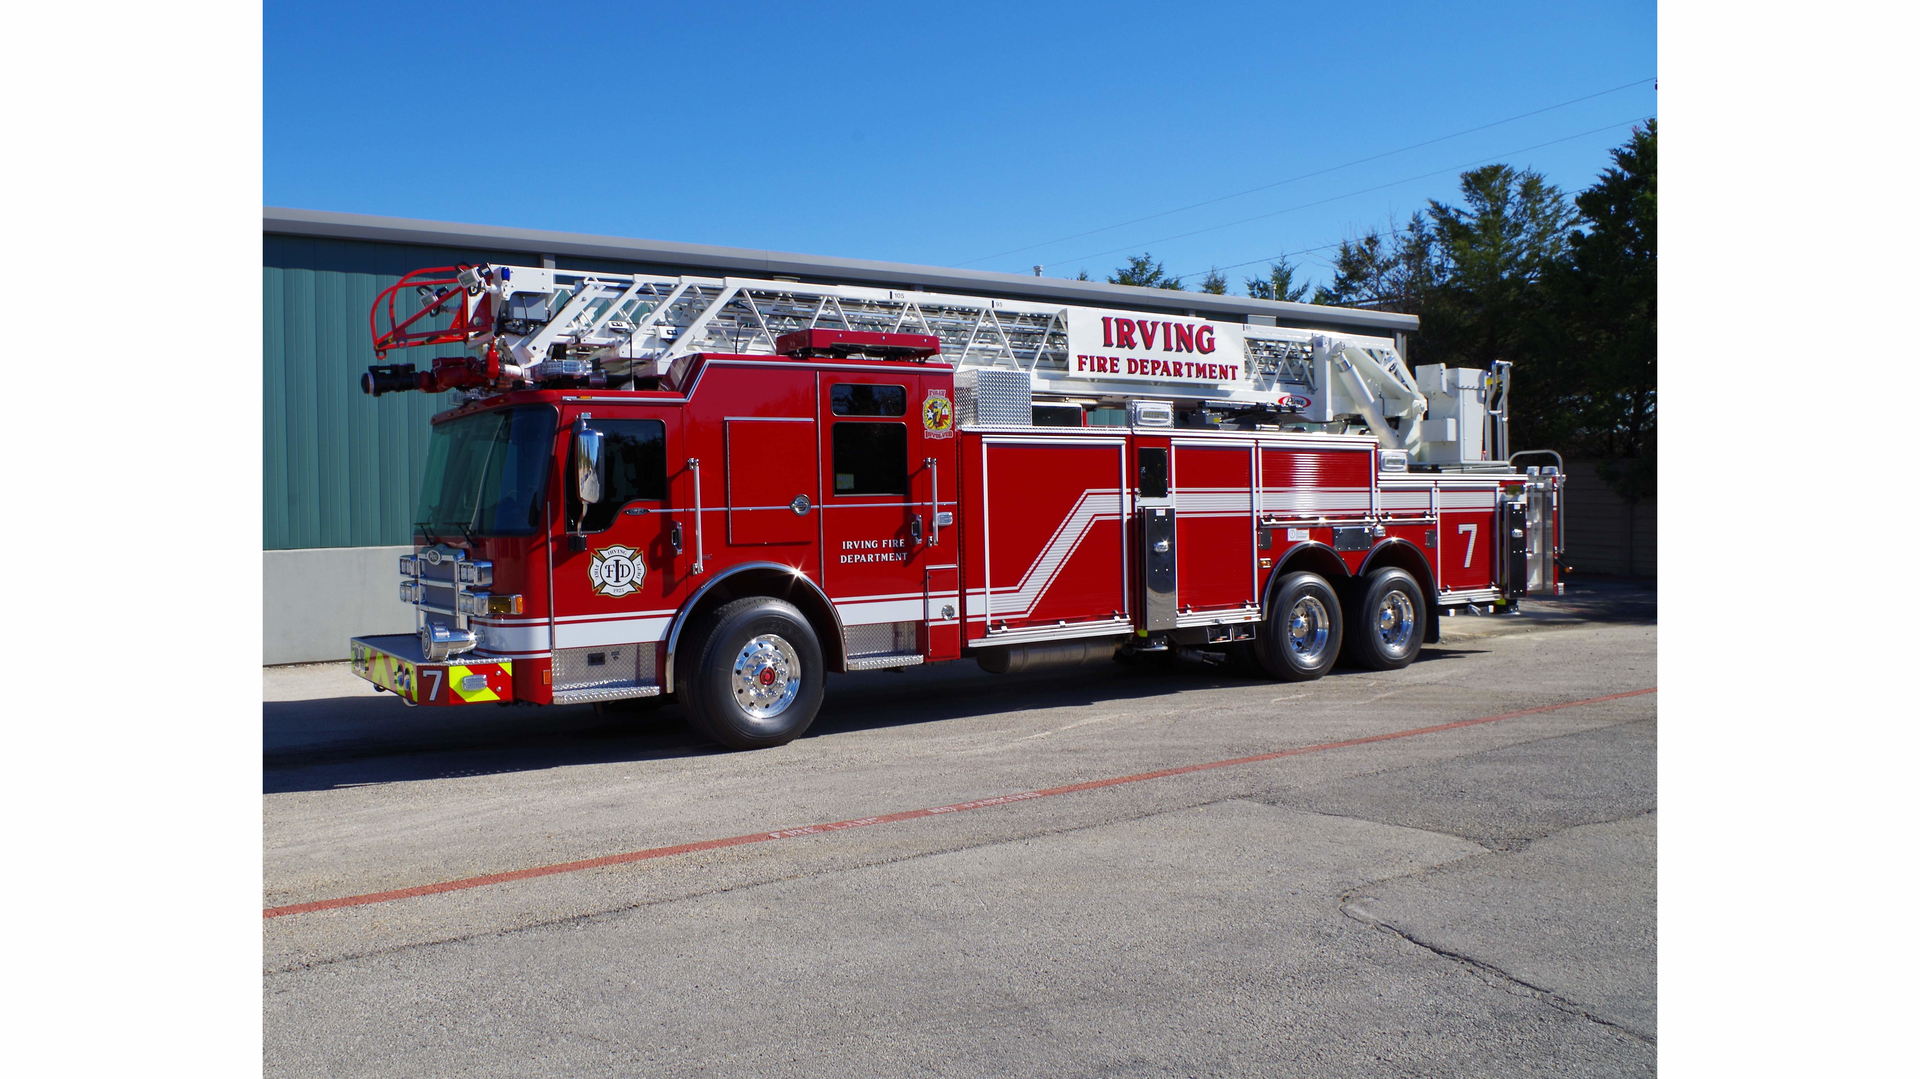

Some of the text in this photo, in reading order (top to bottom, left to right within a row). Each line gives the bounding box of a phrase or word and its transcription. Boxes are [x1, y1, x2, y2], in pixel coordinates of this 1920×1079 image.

[1101, 316, 1216, 355] IRVING
[1077, 354, 1238, 381] FIRE DEPARTMENT
[840, 552, 908, 564] DEPARTMENT
[842, 538, 905, 550] IRVING FIRE
[1458, 523, 1478, 568] 7
[422, 670, 443, 700] 7
